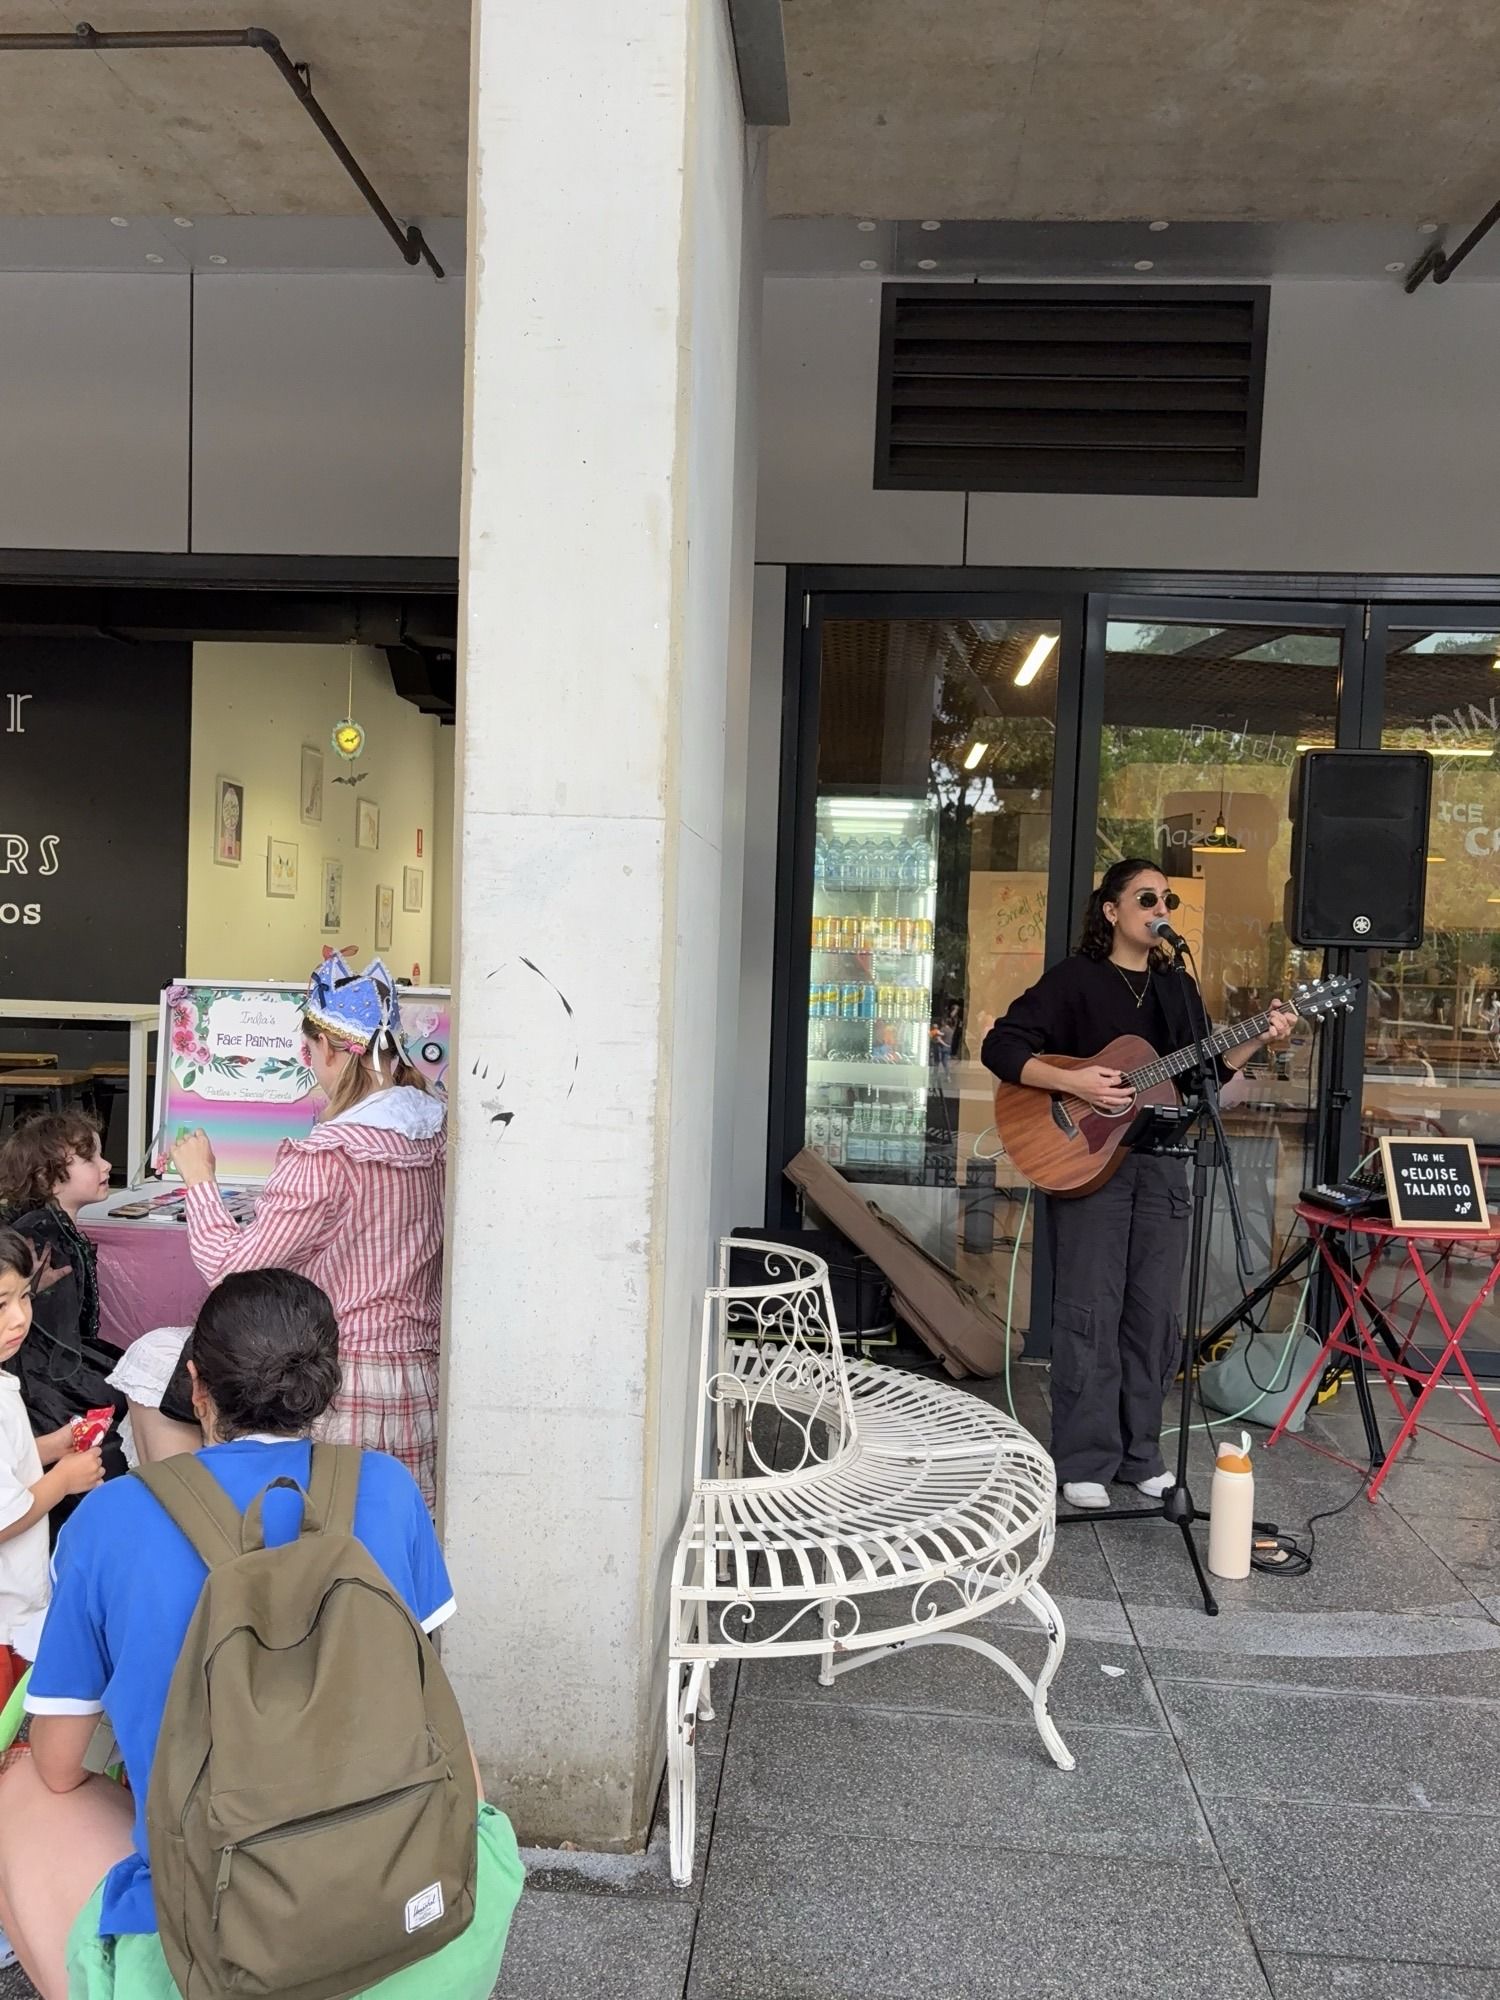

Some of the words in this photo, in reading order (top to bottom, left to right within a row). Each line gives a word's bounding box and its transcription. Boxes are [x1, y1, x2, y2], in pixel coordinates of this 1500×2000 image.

[6, 693, 32, 733] r
[1437, 801, 1484, 824] ICE
[0, 833, 61, 876] RS
[1464, 826, 1500, 857] C
[0, 903, 41, 925] os
[1411, 1152, 1429, 1162] TAG
[1432, 1153, 1446, 1163] ME
